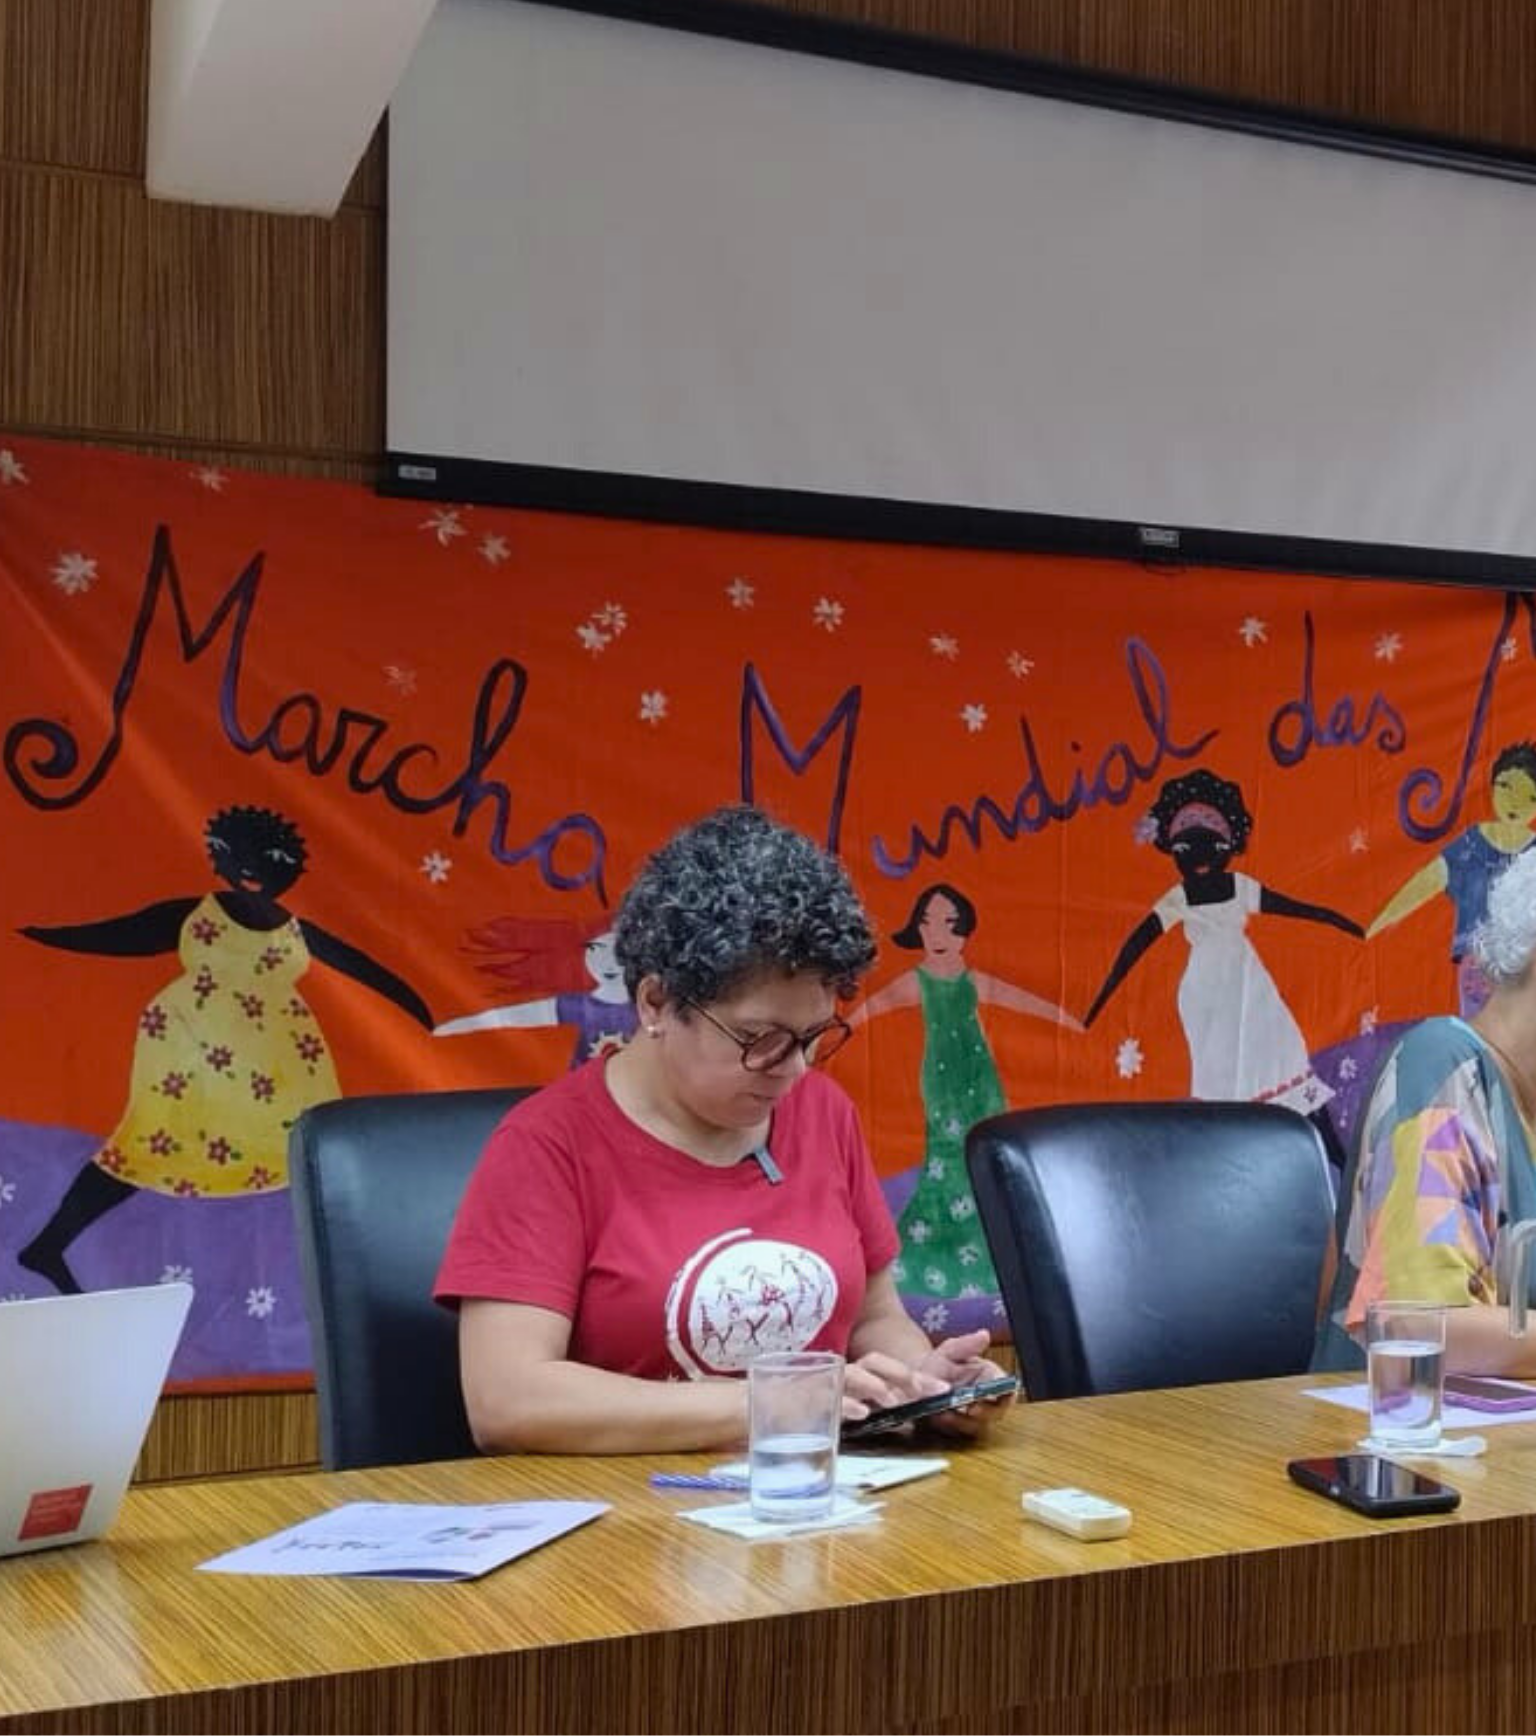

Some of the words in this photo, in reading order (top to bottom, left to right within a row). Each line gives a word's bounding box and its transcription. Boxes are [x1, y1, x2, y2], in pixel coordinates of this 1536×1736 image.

[3, 524, 608, 908] Marcha
[739, 636, 1220, 879] Mundial
[1269, 610, 1406, 767] das
